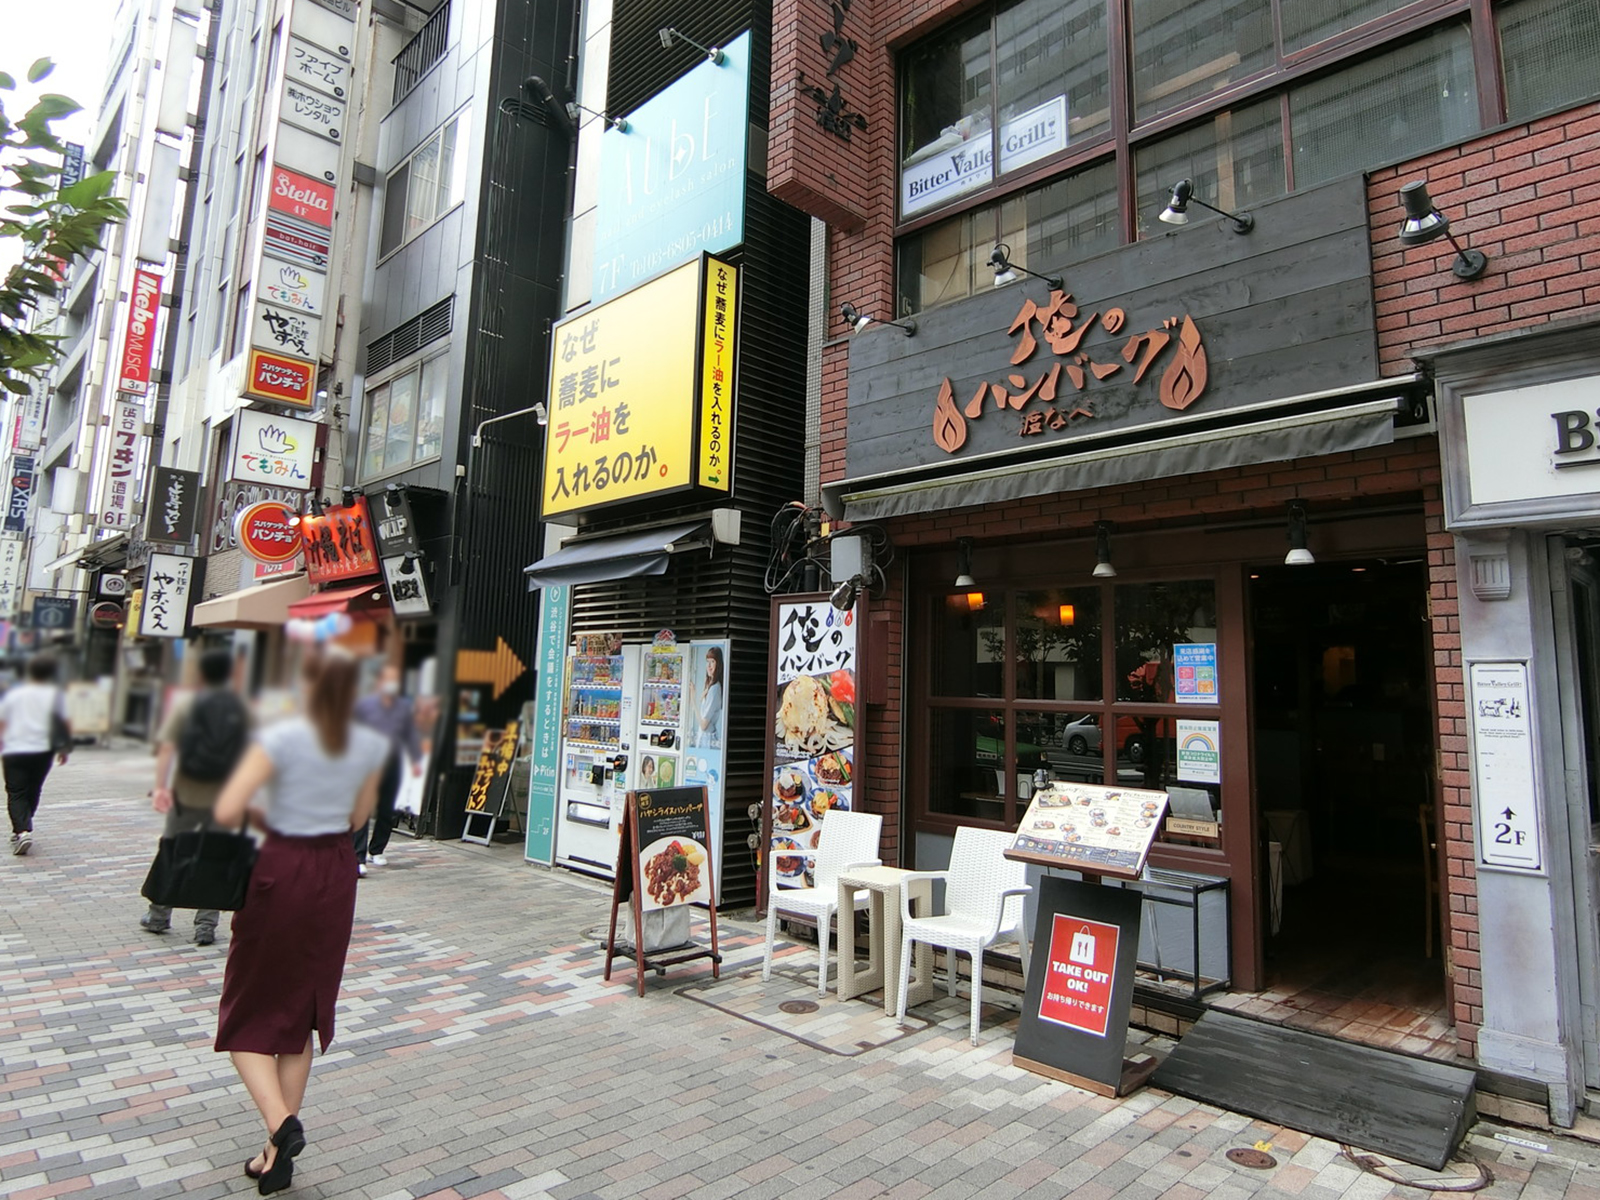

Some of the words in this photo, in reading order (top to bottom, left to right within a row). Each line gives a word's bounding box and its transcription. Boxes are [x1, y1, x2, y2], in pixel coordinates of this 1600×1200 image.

[299, 62, 336, 85] ホーム
[294, 102, 331, 125] レンタル
[700, 158, 735, 183] salon
[909, 168, 952, 199] Bitter
[274, 172, 329, 211] Stella
[599, 253, 625, 294] 7F
[267, 285, 315, 310] てもみん
[262, 307, 310, 356] やすべえ
[561, 318, 600, 363] なぜ
[1007, 289, 1126, 366] 俺の
[259, 371, 302, 391] パンチョ
[964, 316, 1179, 420] ハンバーグ
[127, 380, 141, 390] 3F
[557, 356, 622, 411] 蕎麦に
[554, 401, 631, 454] ラー油を
[241, 454, 307, 480] てもみん
[551, 444, 669, 502] 入れるのか。
[103, 511, 127, 526] 6F
[252, 528, 294, 543] パンチョ
[150, 571, 176, 631] やすべえ
[781, 605, 843, 653] 俺の
[779, 646, 855, 673] ハンバーグ
[1494, 823, 1527, 846] 2F
[1052, 960, 1083, 978] TAKE
[1083, 968, 1110, 984] OUT
[1066, 978, 1089, 993] OK!
[1046, 991, 1105, 1014] お持ち帰りできます
